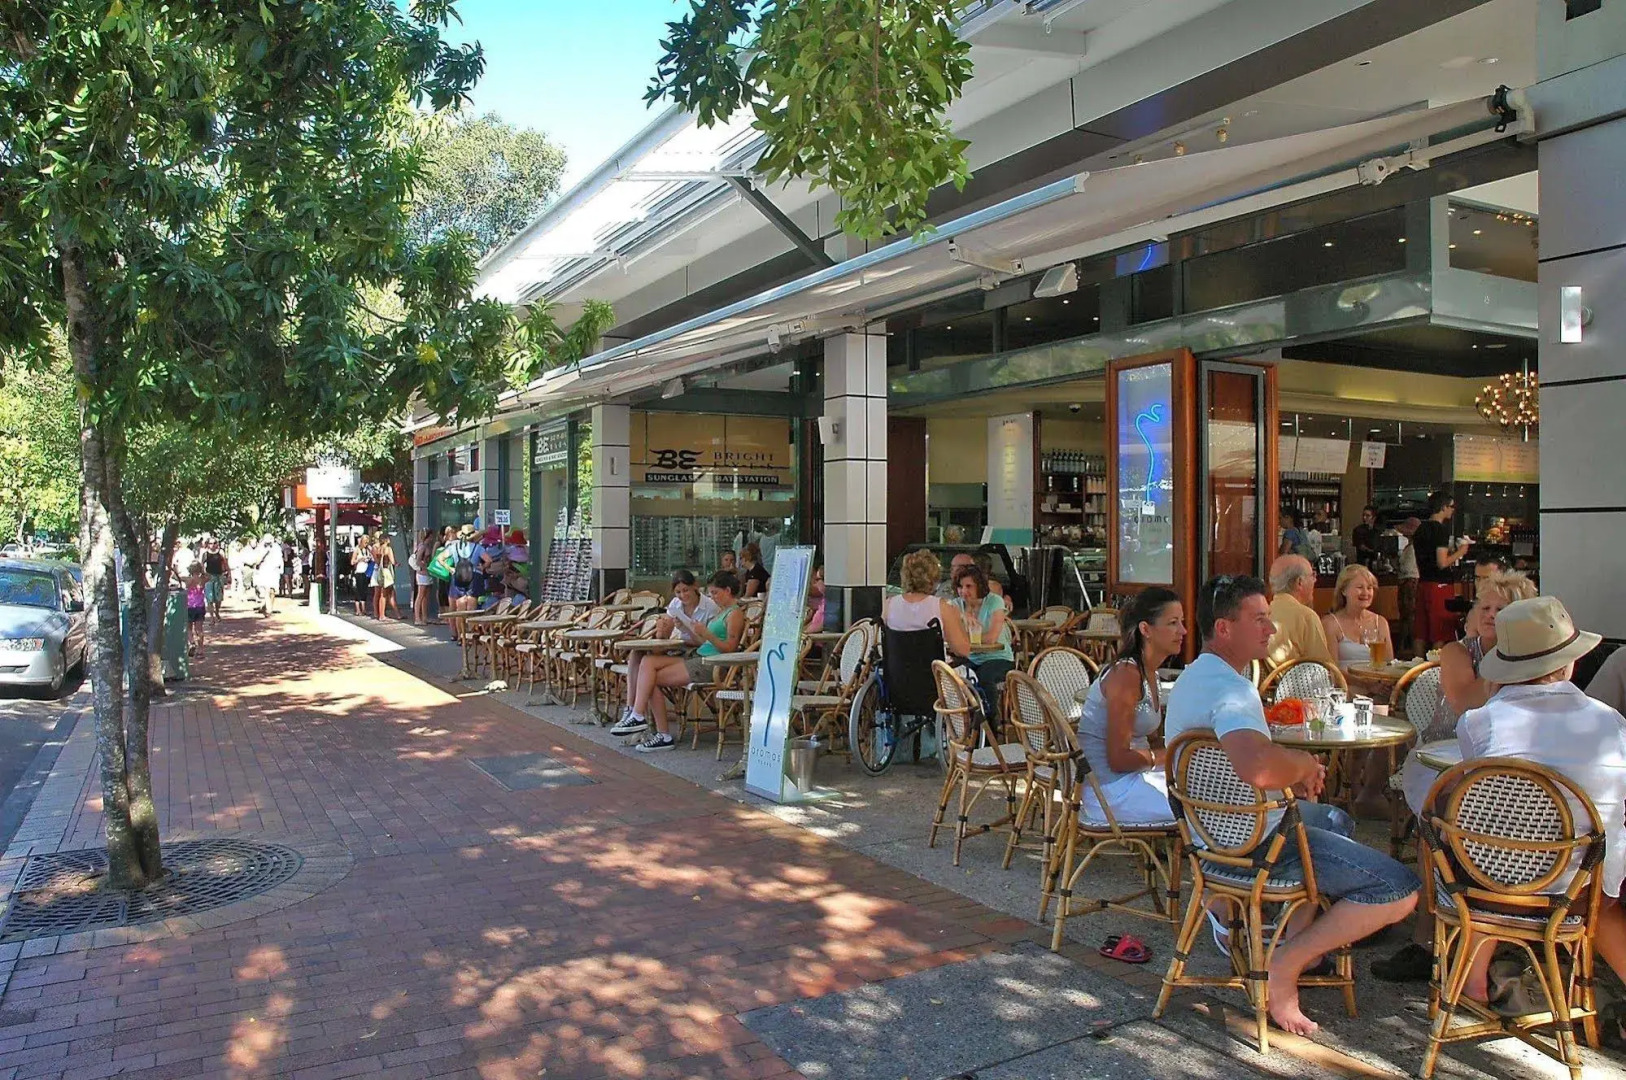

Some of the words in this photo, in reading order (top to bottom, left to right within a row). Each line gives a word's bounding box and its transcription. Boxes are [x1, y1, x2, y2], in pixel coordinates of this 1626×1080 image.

[649, 449, 704, 470] BE
[714, 452, 773, 461] BRIGHT
[738, 475, 777, 483] STATION
